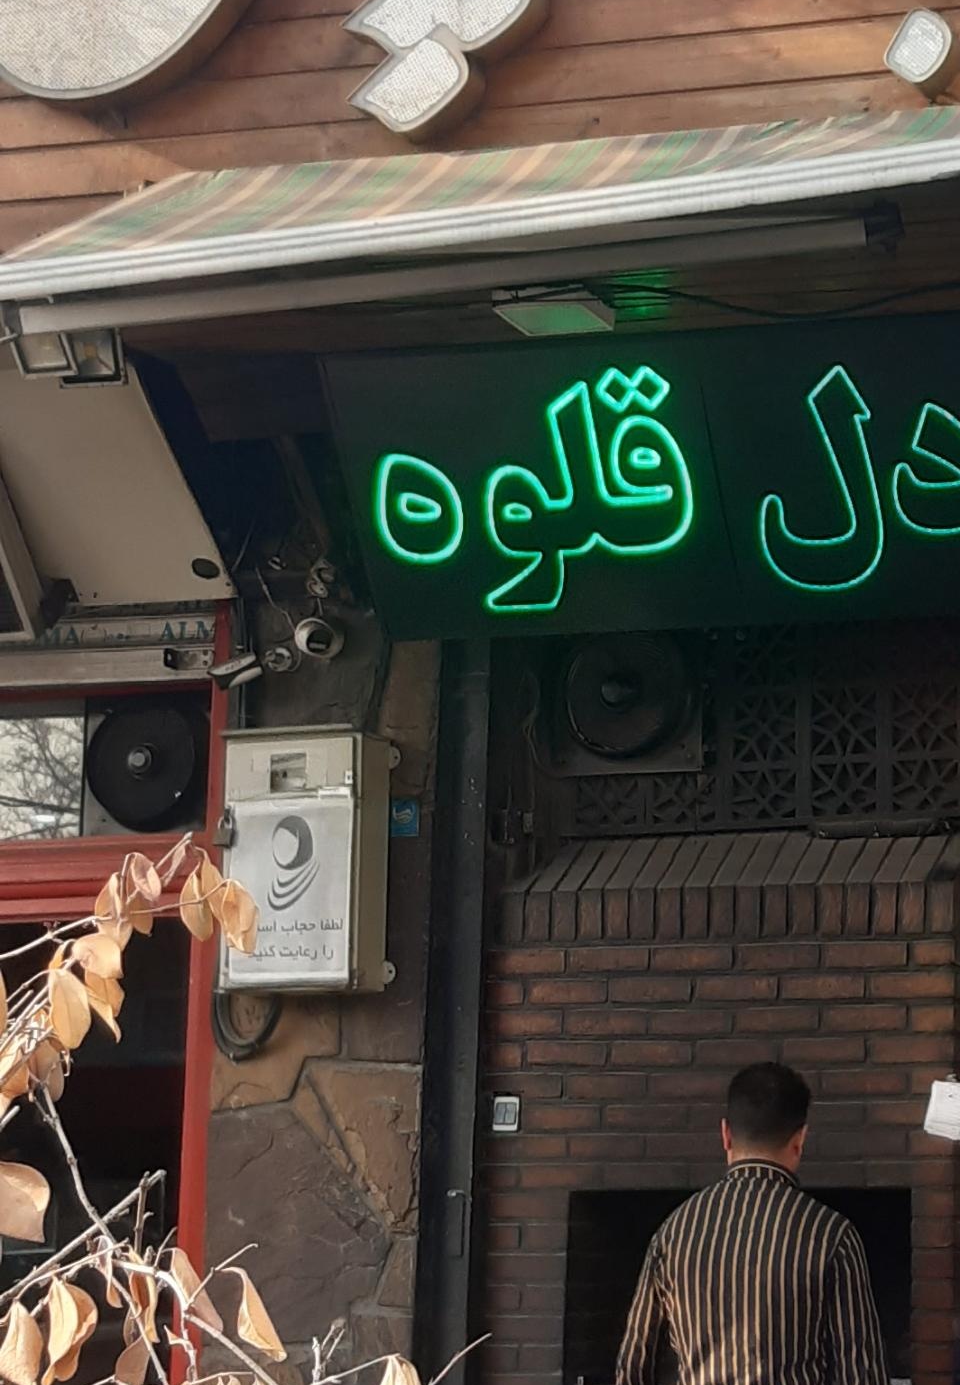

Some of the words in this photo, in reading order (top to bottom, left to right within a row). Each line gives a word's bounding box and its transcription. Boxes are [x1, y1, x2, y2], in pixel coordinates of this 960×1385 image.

[374, 363, 696, 613] قلوه
[281, 919, 317, 936] حجاب
[320, 918, 344, 931] لطفا
[279, 945, 318, 961] رعایت
[322, 944, 334, 961] را
